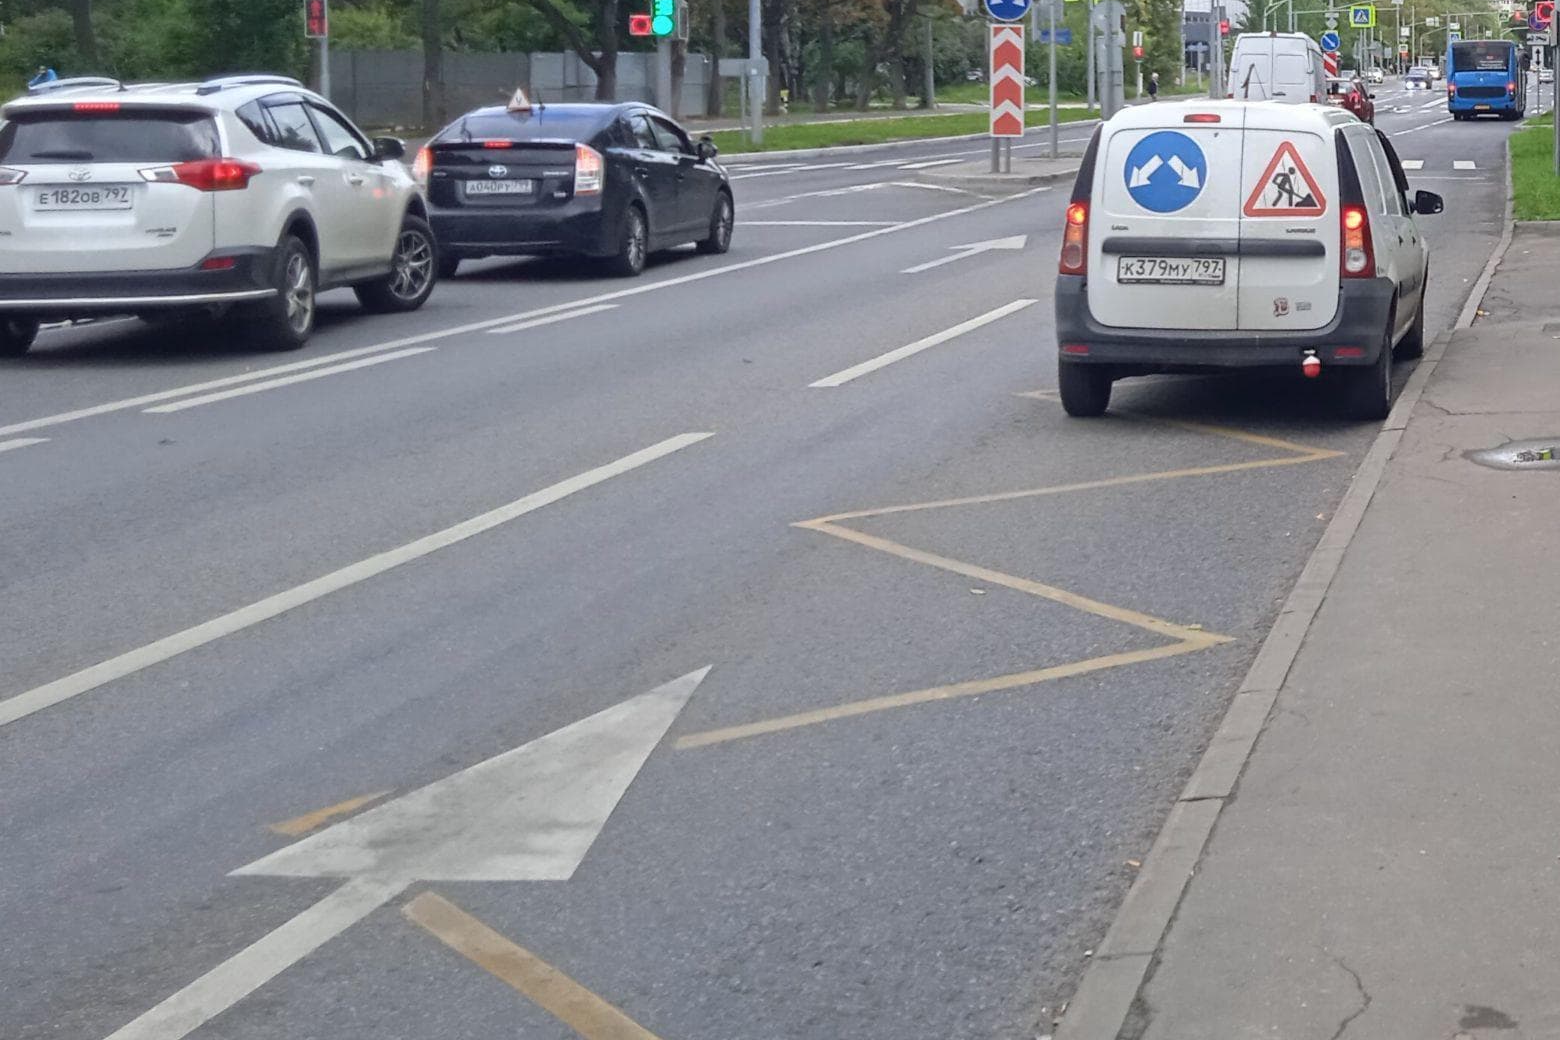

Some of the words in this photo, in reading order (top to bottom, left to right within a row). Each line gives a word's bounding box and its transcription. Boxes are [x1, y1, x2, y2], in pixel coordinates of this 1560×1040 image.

[40, 189, 100, 204] Е182ОВ
[104, 187, 128, 199] 797
[1125, 259, 1190, 277] К379МУ
[1192, 260, 1220, 273] 797
